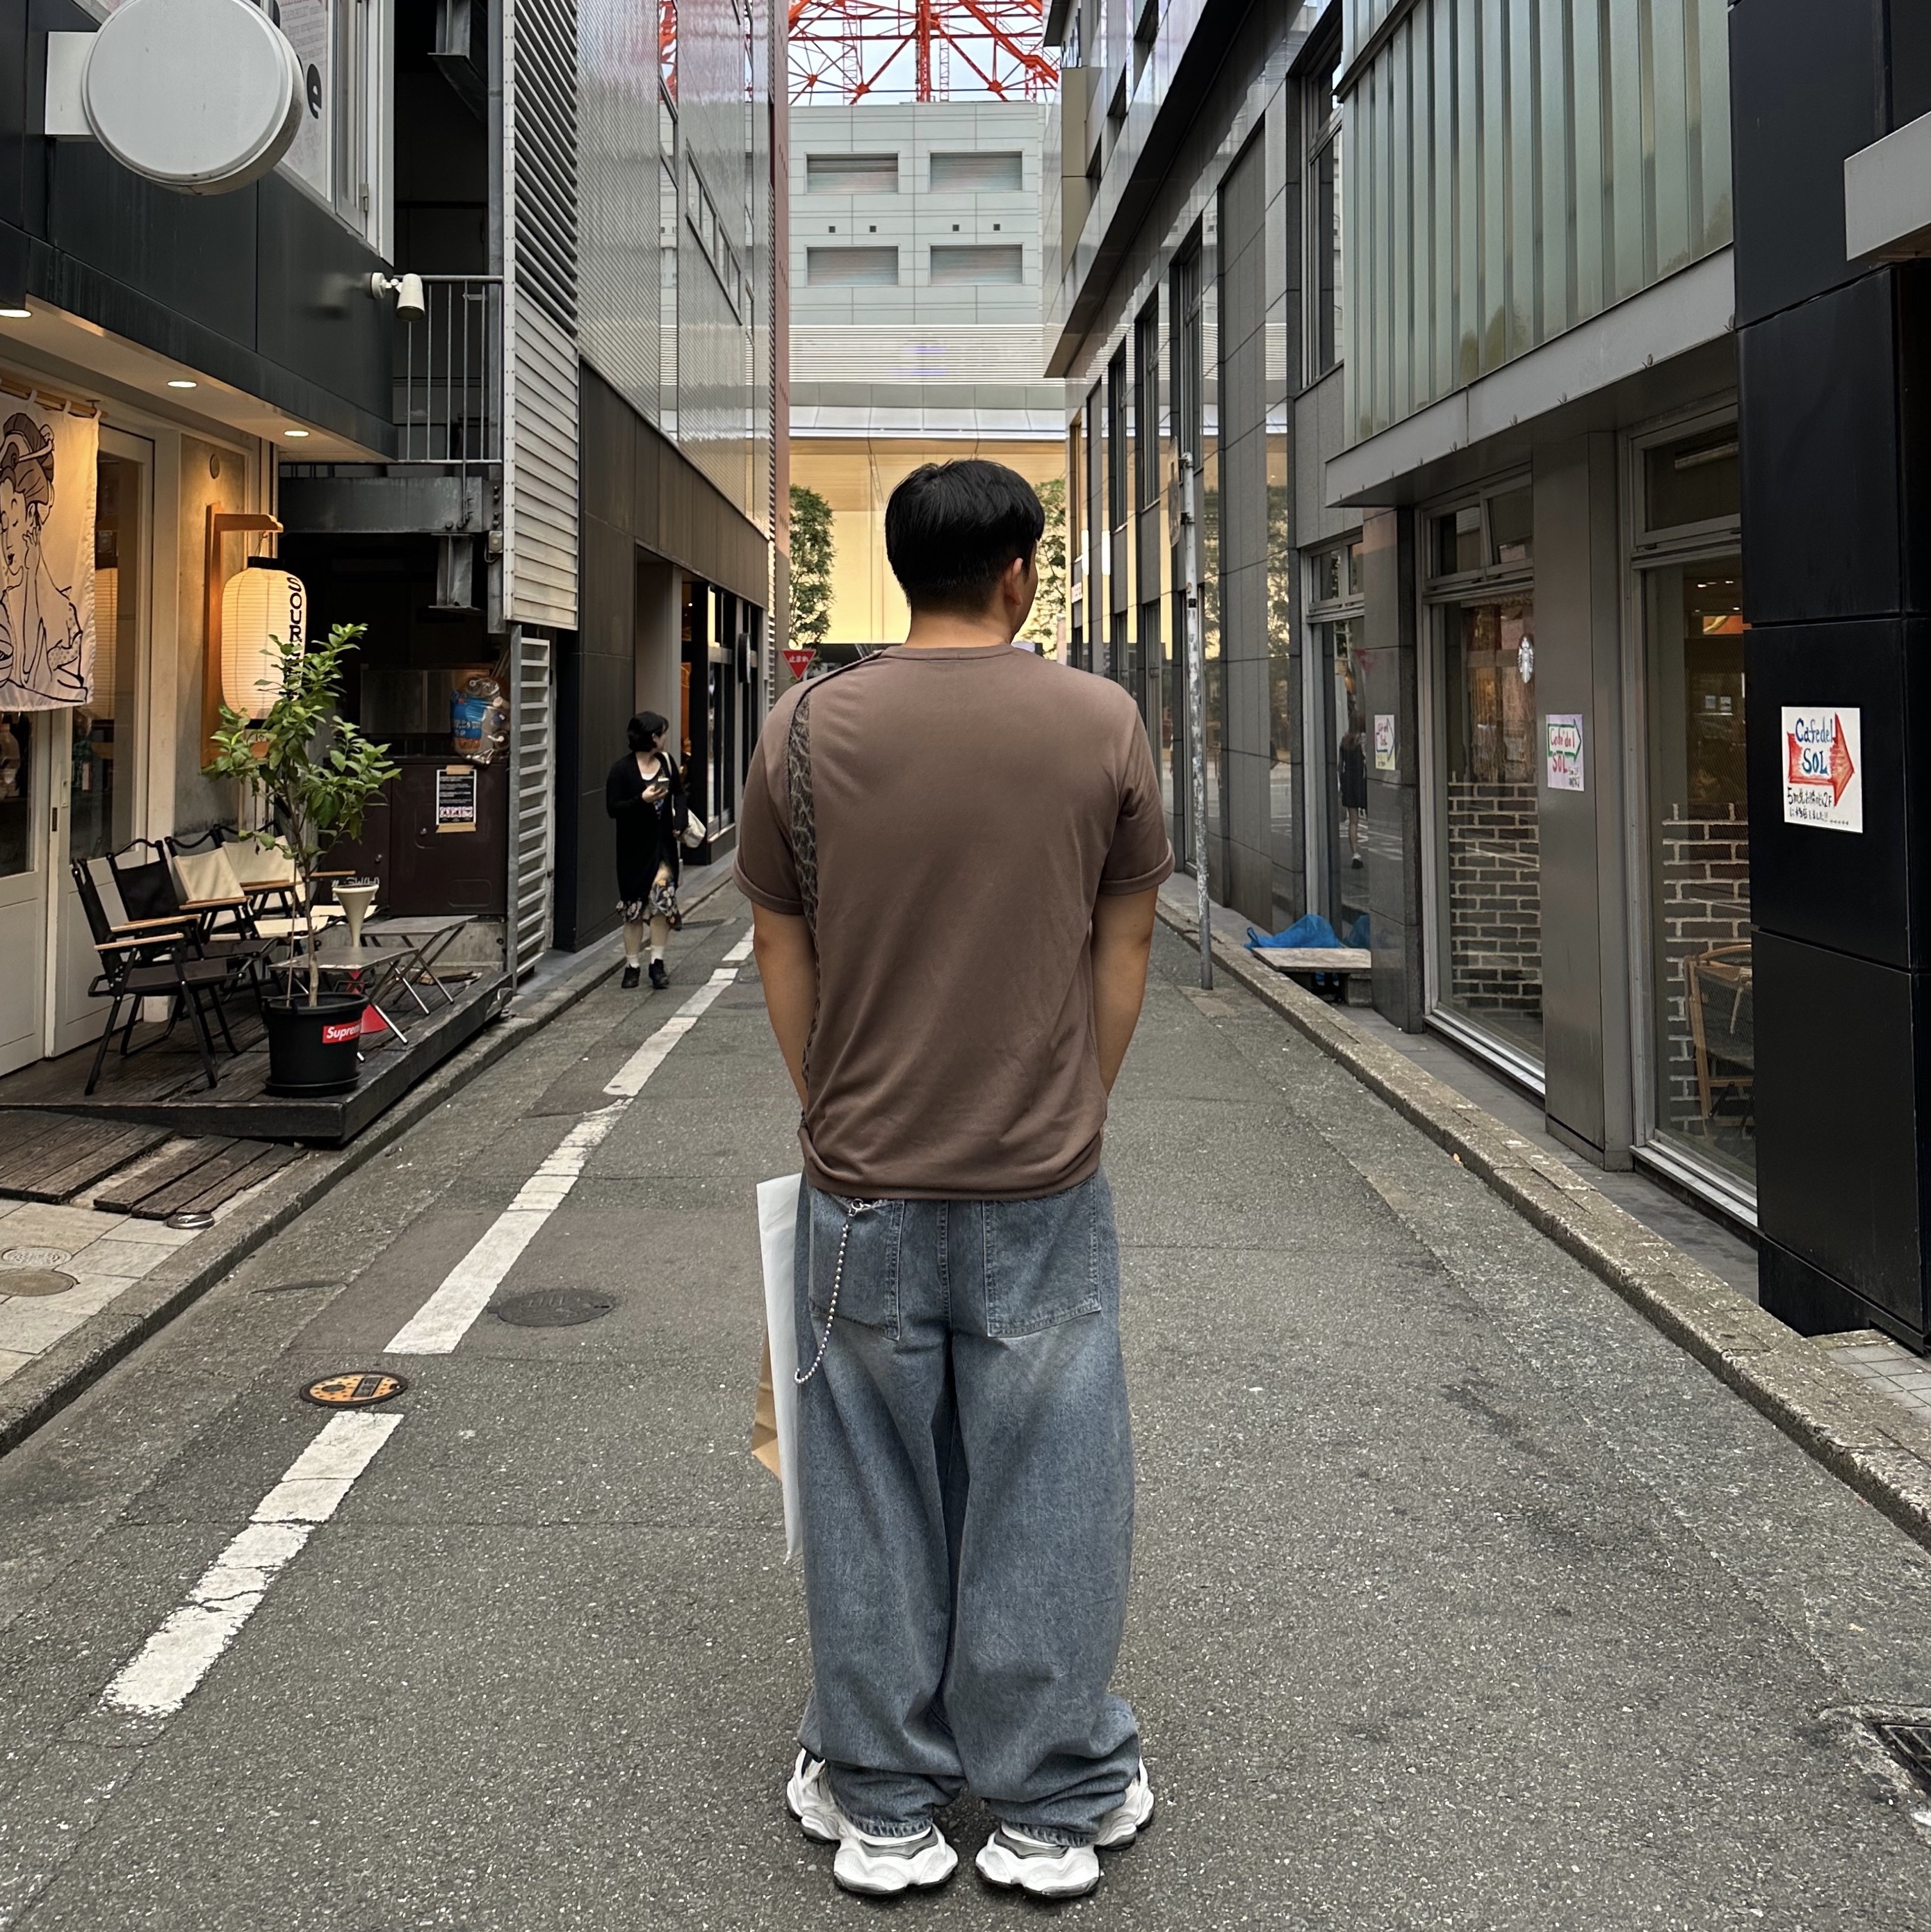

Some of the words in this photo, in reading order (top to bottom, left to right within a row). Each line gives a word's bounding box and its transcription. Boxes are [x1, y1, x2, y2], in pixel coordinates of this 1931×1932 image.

[1552, 751, 1568, 774] SOL
[1802, 748, 1829, 776] SOL
[326, 1024, 361, 1041] Suprem
